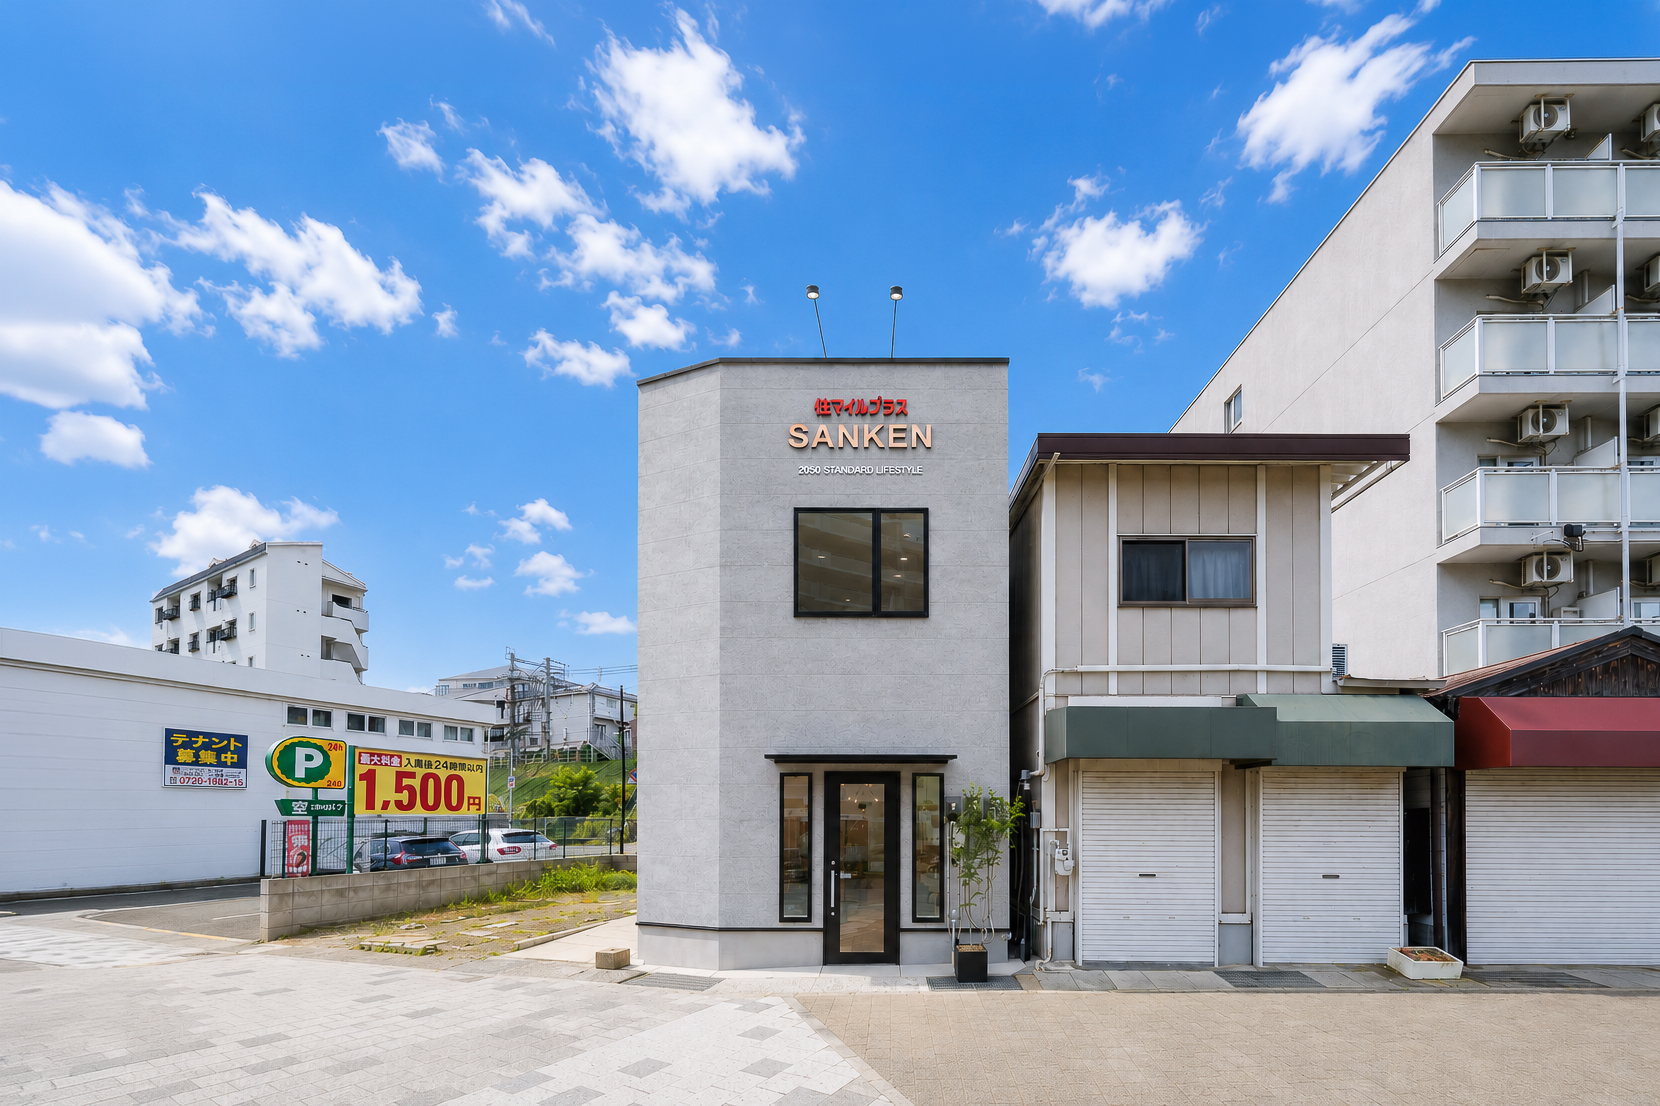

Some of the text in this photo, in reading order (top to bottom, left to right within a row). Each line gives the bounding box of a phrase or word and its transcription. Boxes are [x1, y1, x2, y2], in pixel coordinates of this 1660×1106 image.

[814, 395, 909, 416] 住マイルプラス
[788, 423, 932, 449] SANKEN
[798, 465, 923, 475] 2050 STANDARD LIFESTYLE
[170, 733, 243, 751] テナント
[176, 748, 238, 766] 募集中
[294, 746, 324, 778] P
[291, 800, 308, 815] 空
